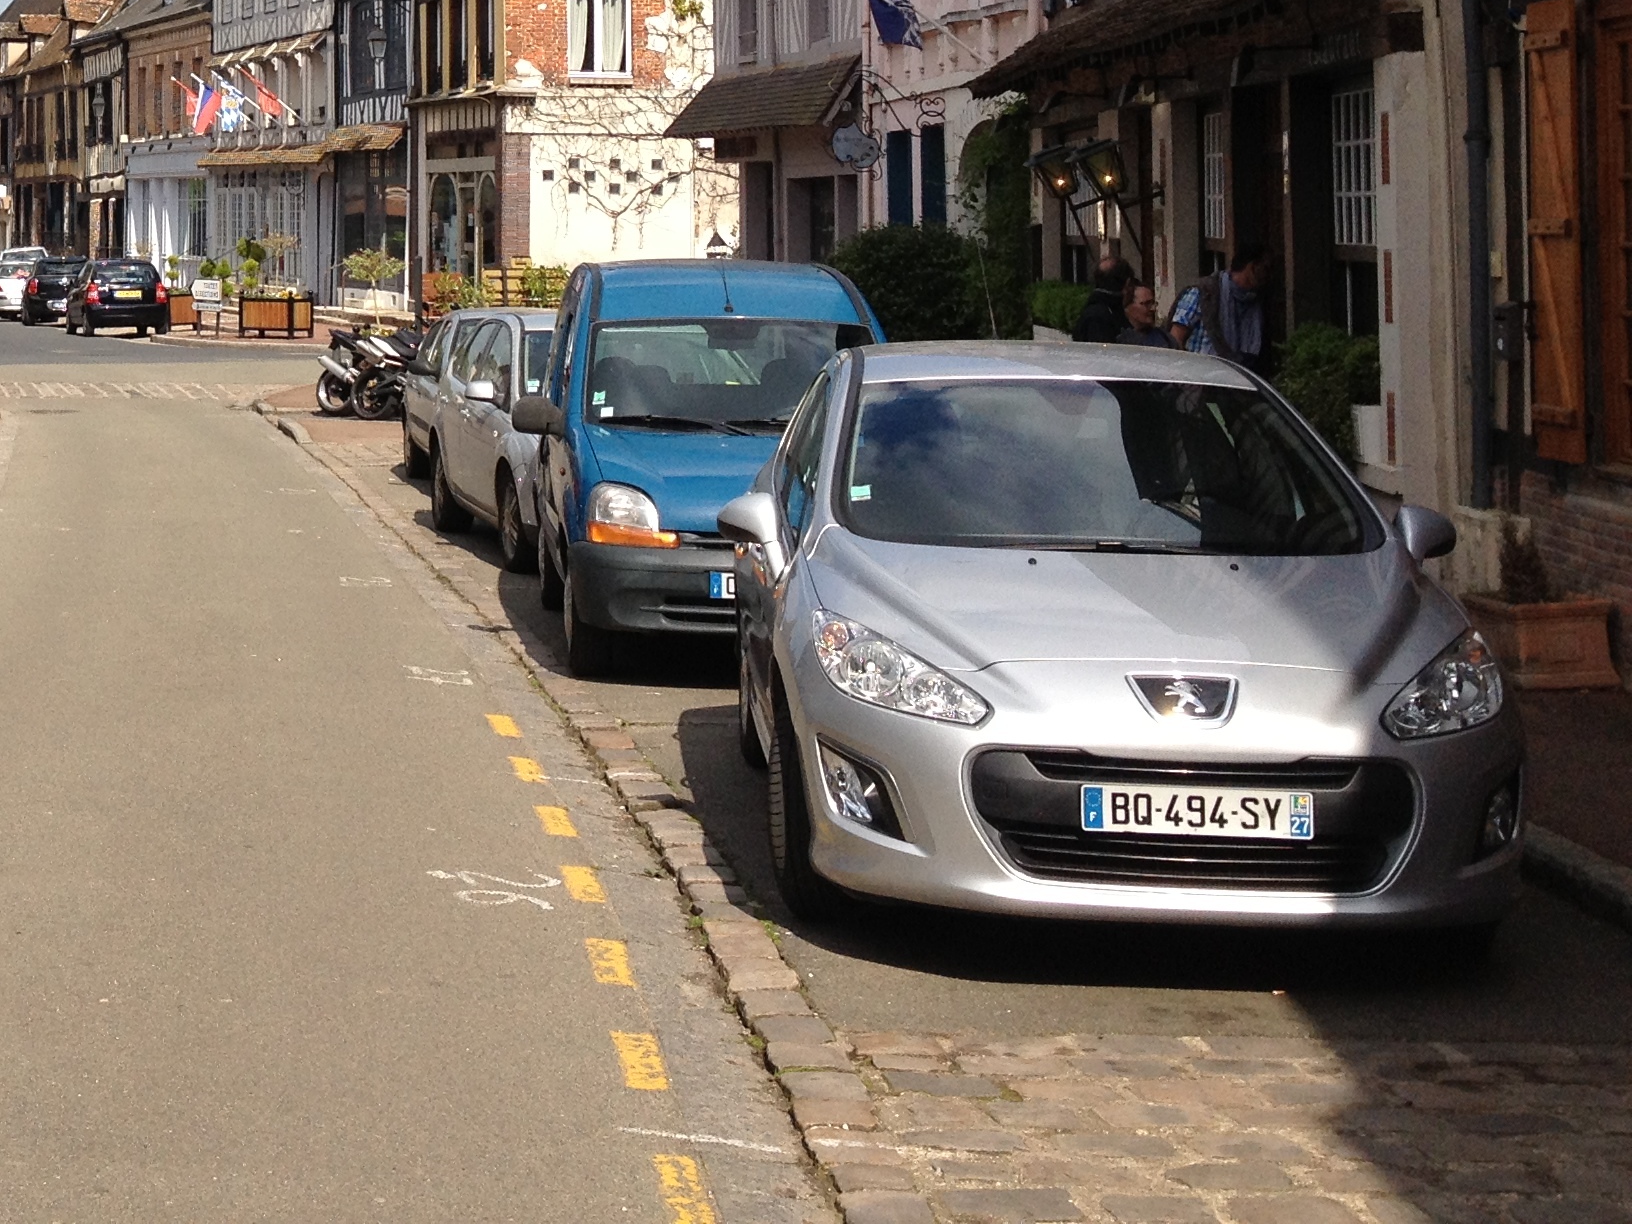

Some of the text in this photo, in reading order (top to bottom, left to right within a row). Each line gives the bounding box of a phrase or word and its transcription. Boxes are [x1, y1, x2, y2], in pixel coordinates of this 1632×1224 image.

[1089, 792, 1310, 834] F BQ-494-SY 27
